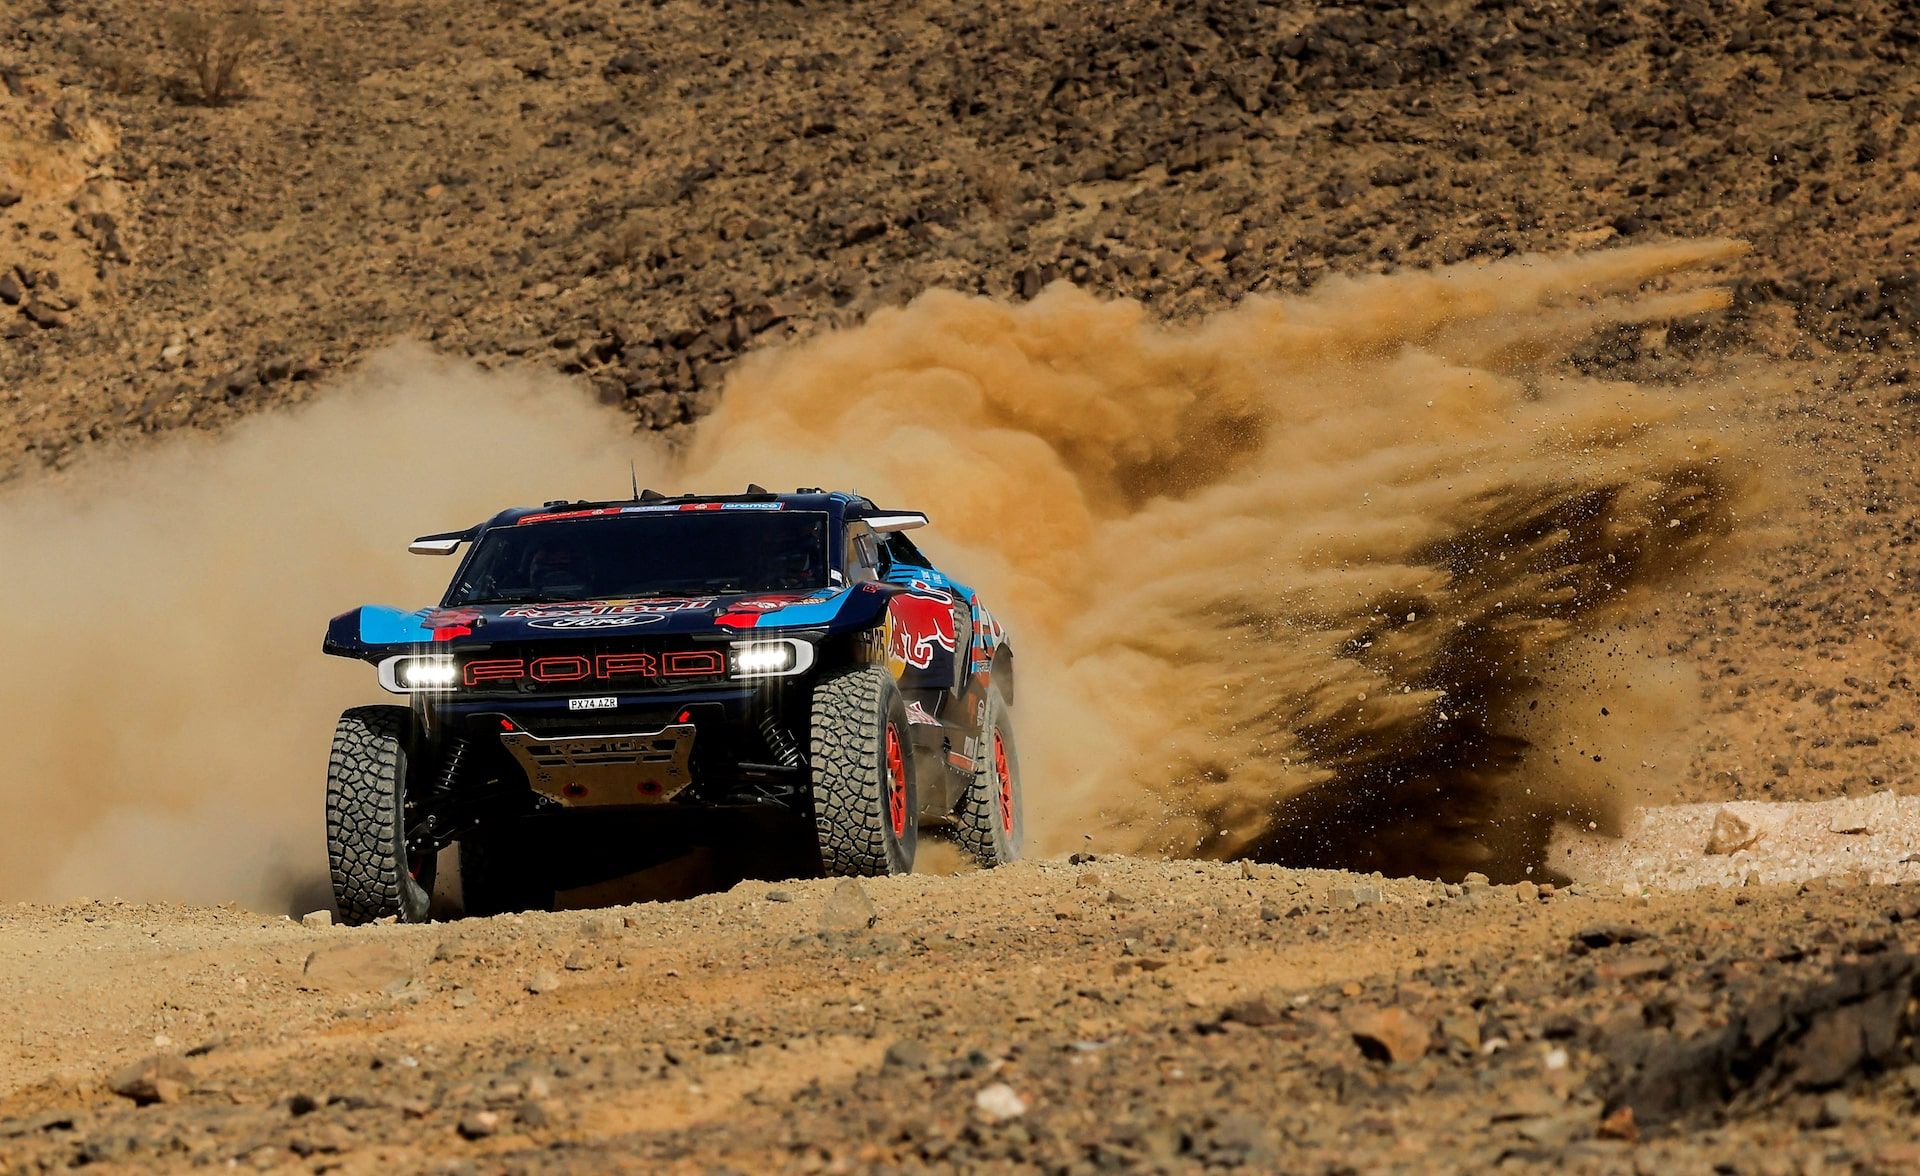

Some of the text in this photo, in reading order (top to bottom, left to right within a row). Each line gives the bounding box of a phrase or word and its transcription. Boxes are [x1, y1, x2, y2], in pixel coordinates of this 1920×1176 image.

[499, 600, 714, 619] Red Bull
[552, 615, 638, 627] Ford
[463, 650, 725, 686] FORD
[571, 698, 615, 709] PX74 AZR
